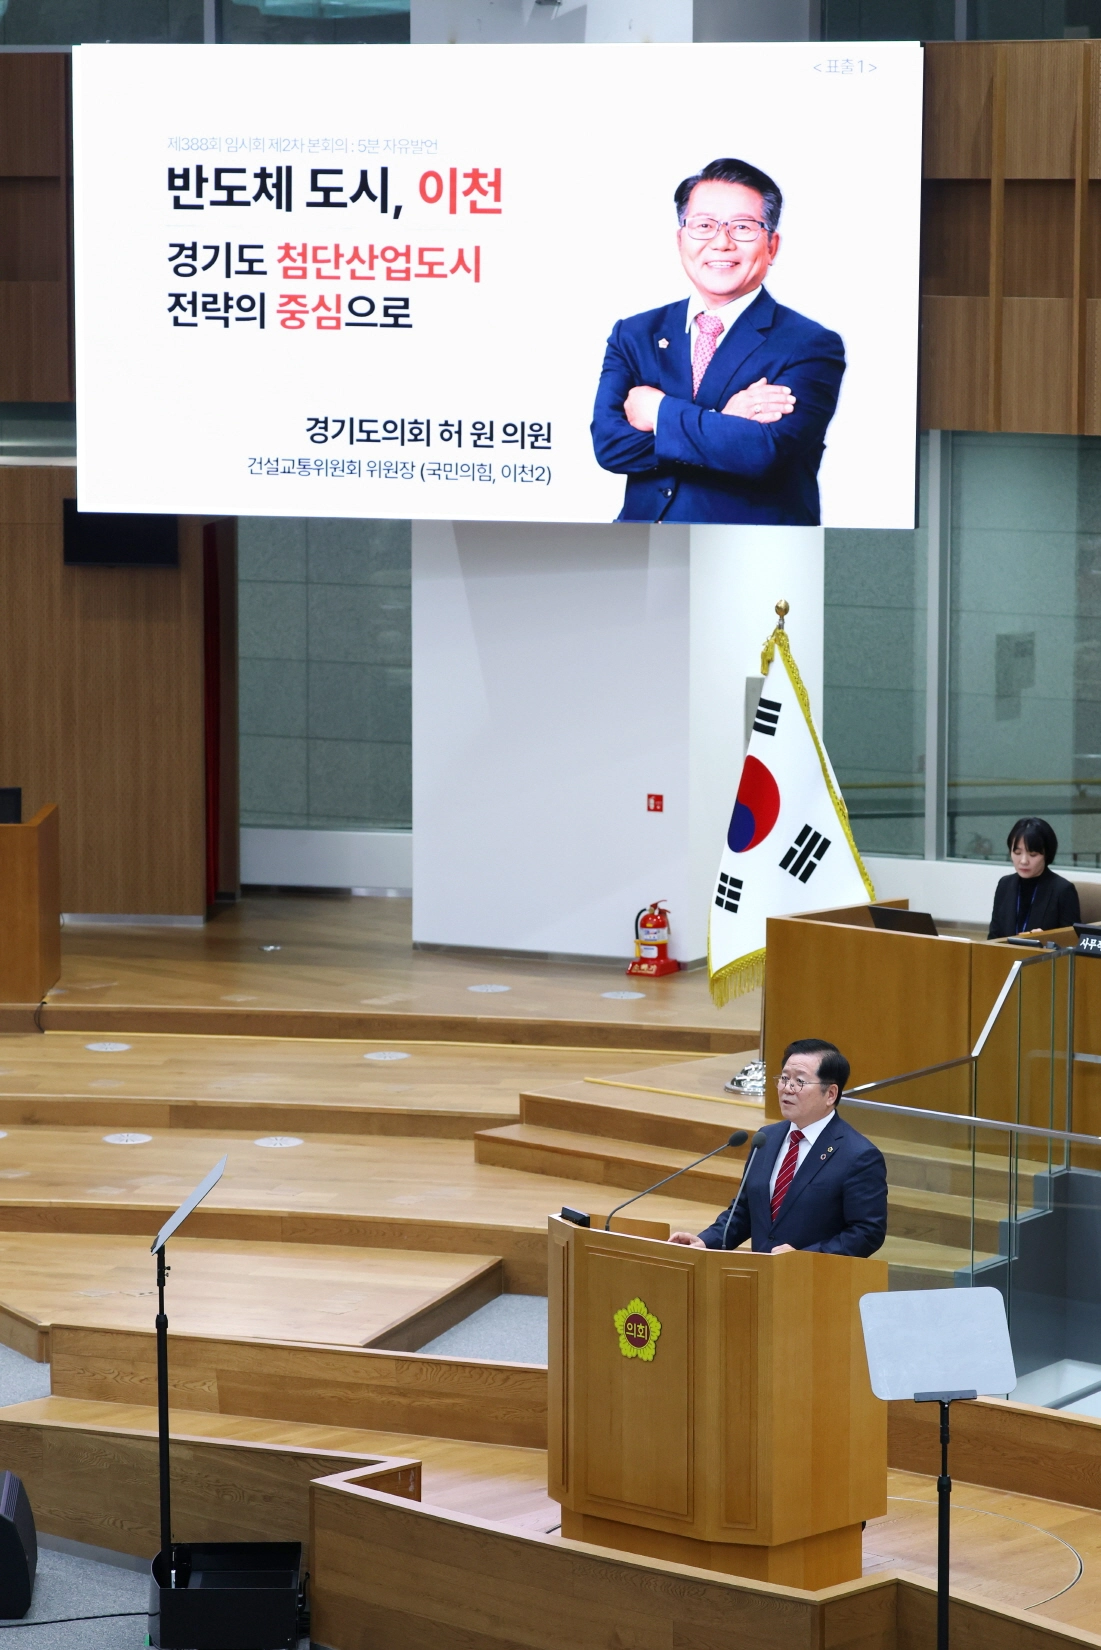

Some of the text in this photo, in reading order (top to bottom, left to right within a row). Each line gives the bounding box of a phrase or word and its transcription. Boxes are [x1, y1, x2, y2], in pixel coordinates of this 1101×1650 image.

[167, 136, 222, 153] 제388회
[225, 136, 265, 153] 임시회
[268, 137, 306, 154] 제2차
[383, 139, 438, 155] 자유발언
[168, 164, 502, 219] 반도체 도시, 이천
[168, 241, 481, 283] 경기도 첨단산업도시
[167, 291, 413, 330] 전략의 중심으로
[306, 416, 431, 447] 경기도의회
[501, 421, 552, 450] 의원
[248, 456, 552, 486] 건설교통위원회 위원장 (국민의힘, 이천2)
[626, 1323, 648, 1340] 의회
